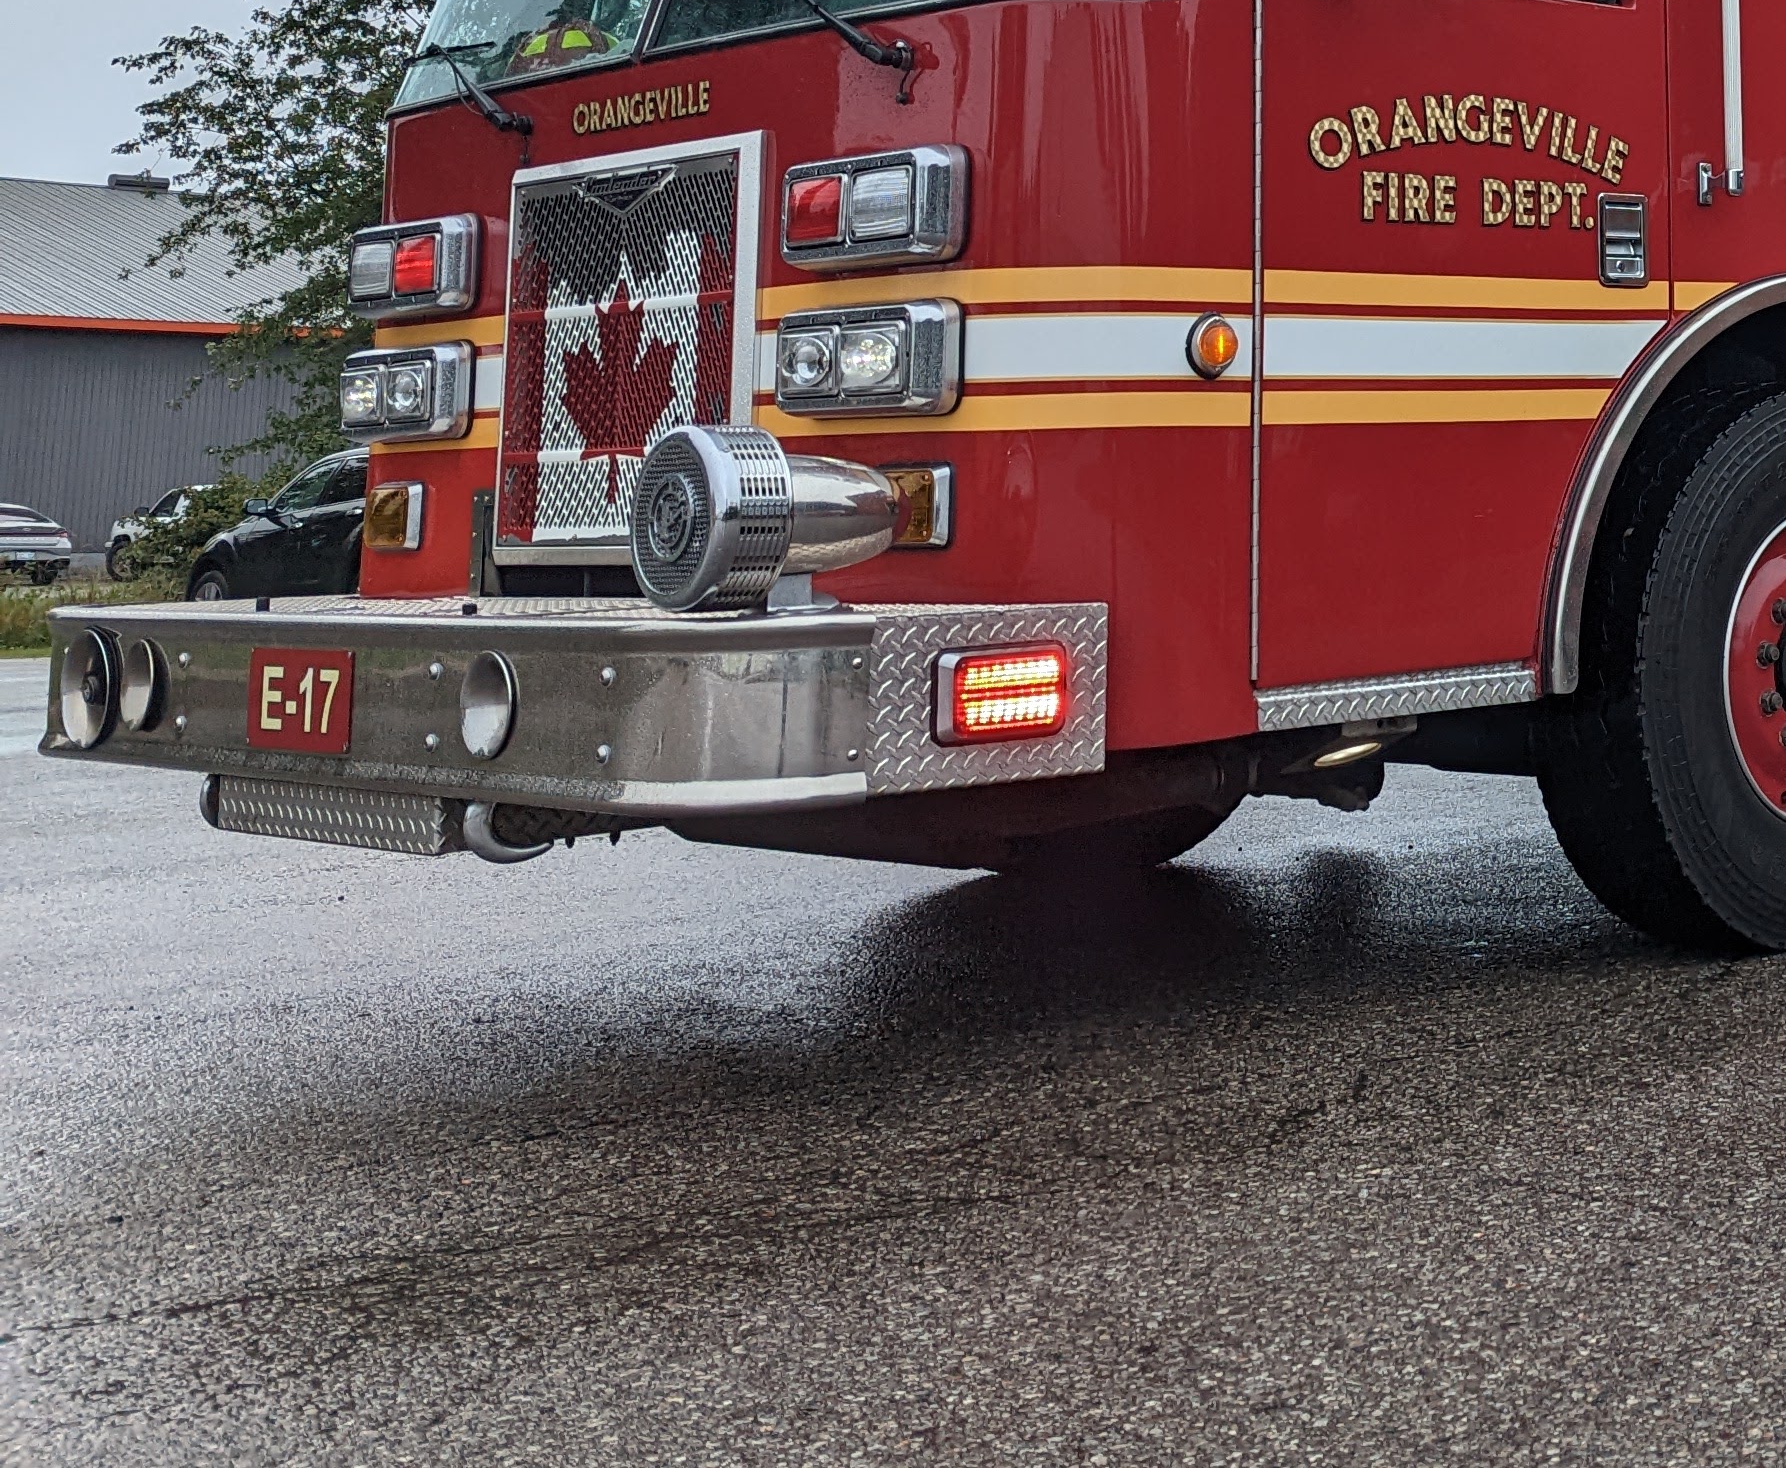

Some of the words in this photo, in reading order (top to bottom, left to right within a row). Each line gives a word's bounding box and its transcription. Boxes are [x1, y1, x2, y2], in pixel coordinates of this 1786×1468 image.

[571, 79, 711, 135] ORANGEVILLE
[1308, 93, 1630, 185] ORANGEVILLE
[1361, 170, 1457, 224] FIRE
[1482, 177, 1596, 230] DEPT.
[260, 665, 340, 734] E-17
